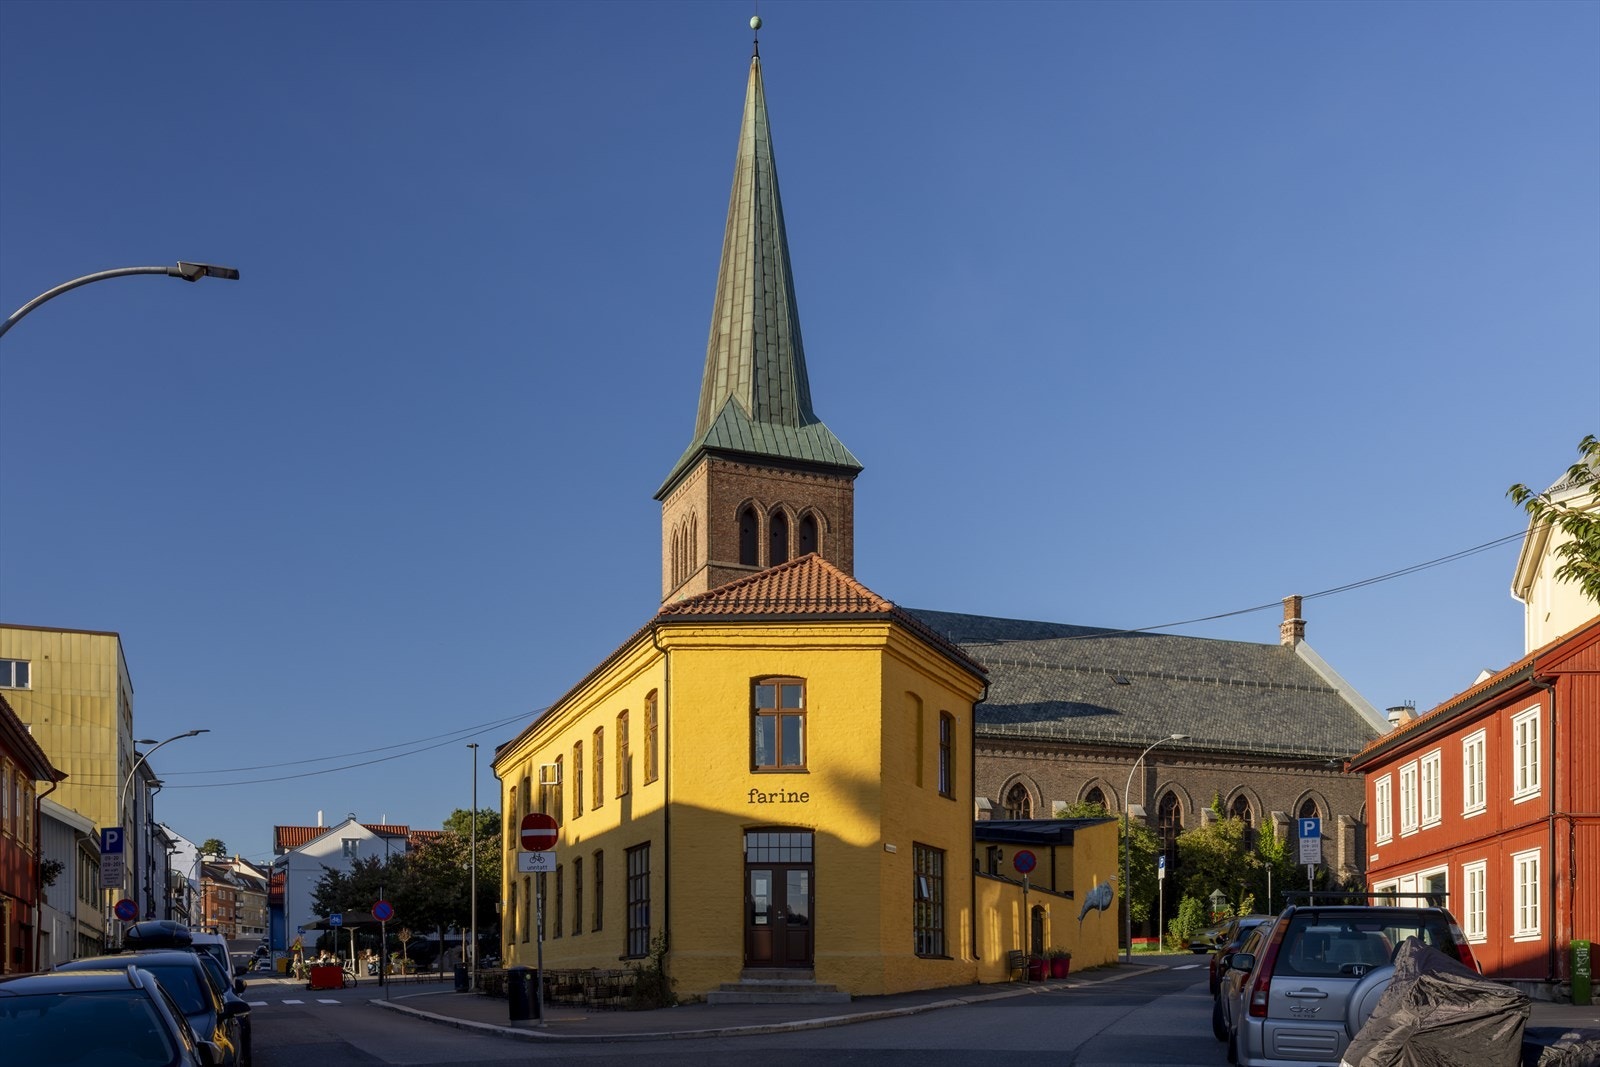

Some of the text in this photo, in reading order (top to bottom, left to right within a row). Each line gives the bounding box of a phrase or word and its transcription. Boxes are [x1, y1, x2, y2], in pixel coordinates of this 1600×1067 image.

[748, 788, 810, 804] farine
[1304, 821, 1315, 836] P
[106, 831, 118, 850] P
